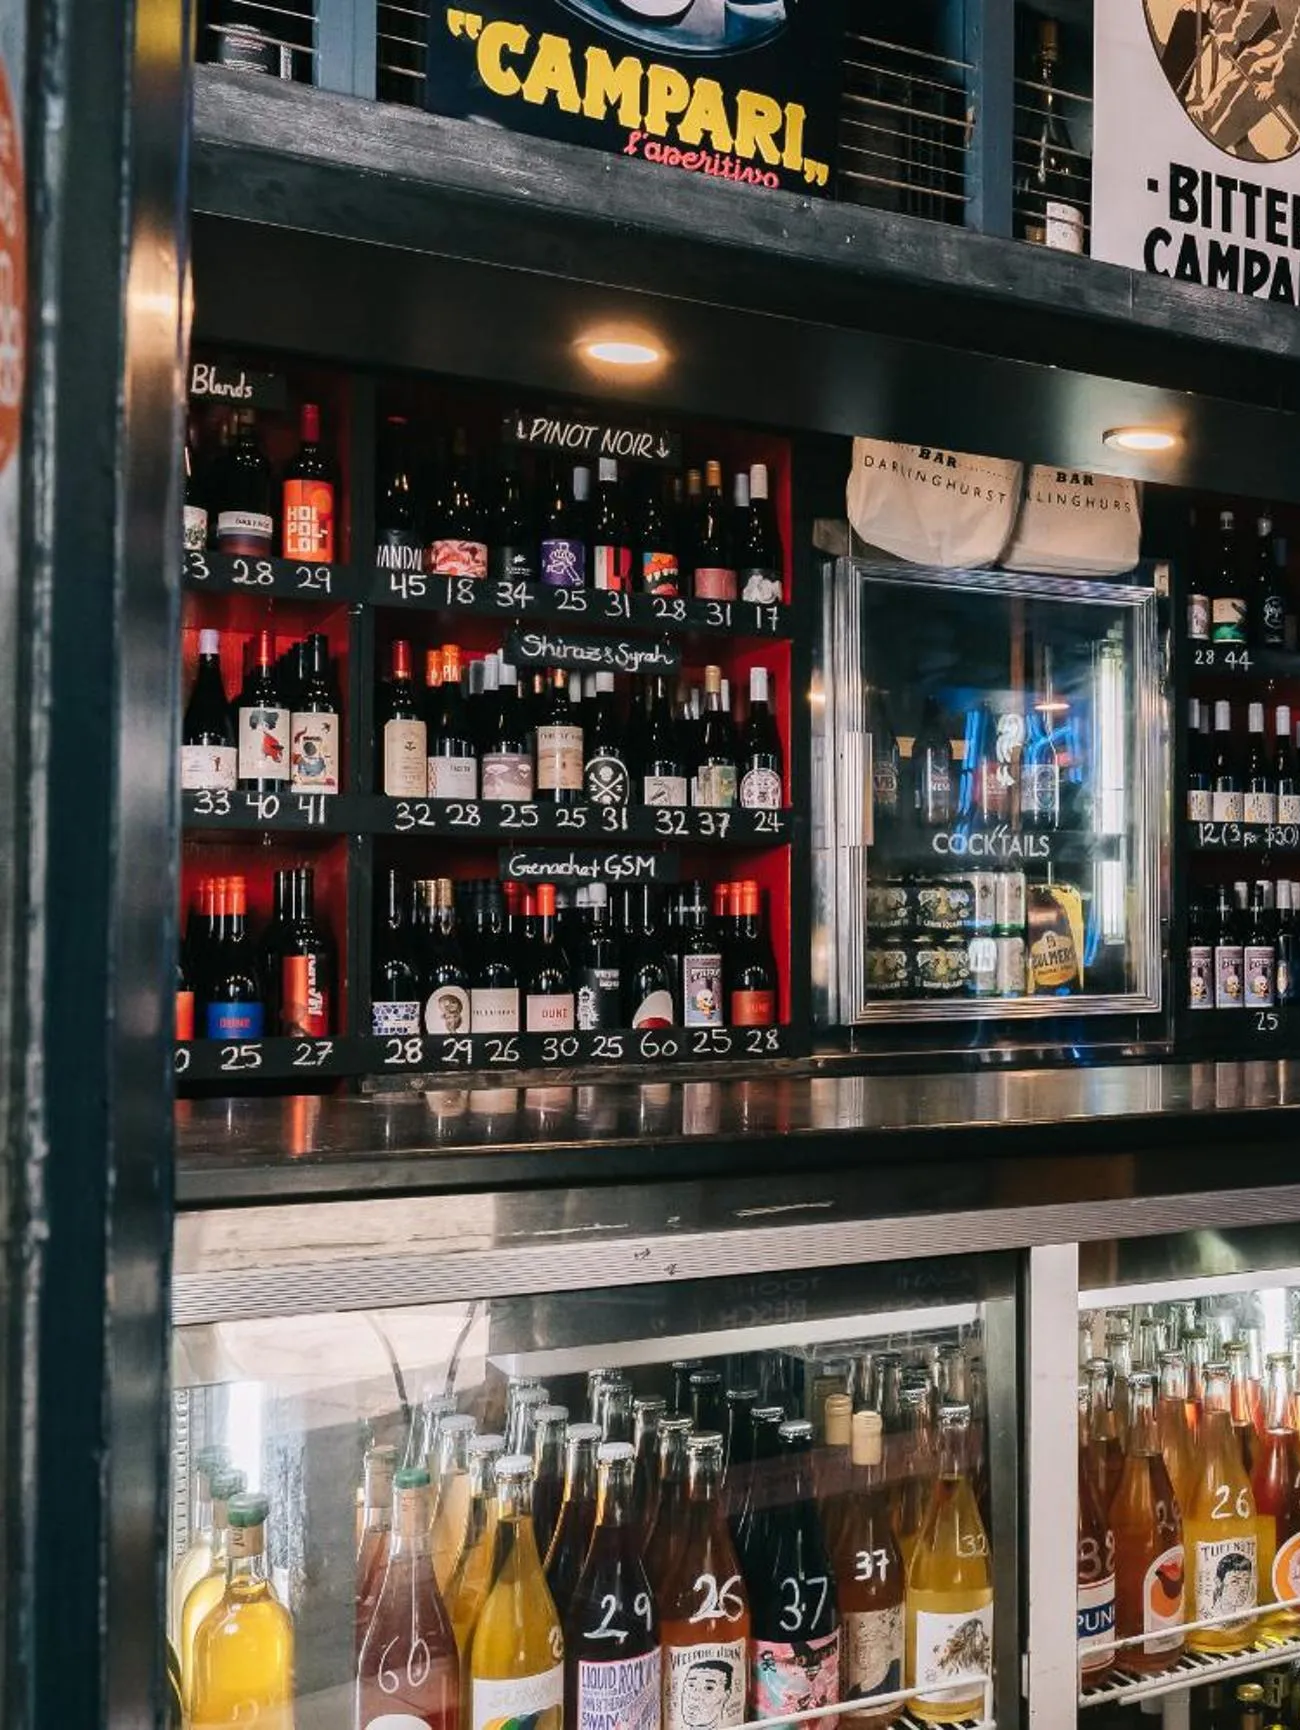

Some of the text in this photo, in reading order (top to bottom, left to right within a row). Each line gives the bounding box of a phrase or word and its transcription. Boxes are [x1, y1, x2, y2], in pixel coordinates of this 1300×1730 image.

[190, 363, 253, 399] Blends
[530, 417, 654, 458] PINOT NOIR
[918, 447, 959, 469] BAR
[863, 454, 1008, 505] DARLINGHURST
[1055, 470, 1095, 487] BAR
[232, 558, 275, 586] 28
[295, 566, 332, 594] 29
[390, 574, 428, 600] 45
[446, 577, 476, 606] 18
[554, 587, 589, 613] 25
[604, 591, 631, 620] 31
[652, 598, 687, 622] 28
[706, 601, 732, 628] 31
[755, 606, 780, 631] 17
[521, 633, 602, 662] Shiraz
[615, 642, 675, 673] Syrah
[1194, 650, 1215, 666] 28
[1224, 650, 1254, 672] 44
[193, 788, 232, 817] 33
[245, 795, 280, 821] 40
[298, 795, 326, 825] 41
[501, 803, 540, 828] 25
[394, 803, 436, 831] 32
[445, 804, 482, 828] 28
[555, 808, 589, 829] 25
[603, 806, 629, 832] 31
[655, 810, 691, 836] 32
[699, 811, 731, 839] 37
[753, 810, 785, 833] 24
[931, 828, 1050, 858] COCKTAILS
[1199, 822, 1221, 848] 12
[604, 853, 656, 881] GSM
[1253, 1011, 1280, 1031] 25
[384, 1038, 423, 1064] 28
[441, 1038, 473, 1064] 29
[484, 1040, 521, 1063] 26
[541, 1037, 580, 1061] 30
[590, 1036, 624, 1058] 25
[640, 1030, 678, 1057] 60
[692, 1029, 732, 1053] 25
[745, 1028, 780, 1052] 28
[221, 1044, 263, 1070] 25
[292, 1041, 334, 1066] 27
[1211, 1485, 1251, 1521] 26
[855, 1549, 890, 1583] 37
[689, 1573, 744, 1624] 26
[779, 1576, 828, 1632] 37
[583, 1591, 653, 1645] 29
[378, 1636, 432, 1694] 60
[581, 1664, 617, 1691] LIQUID
